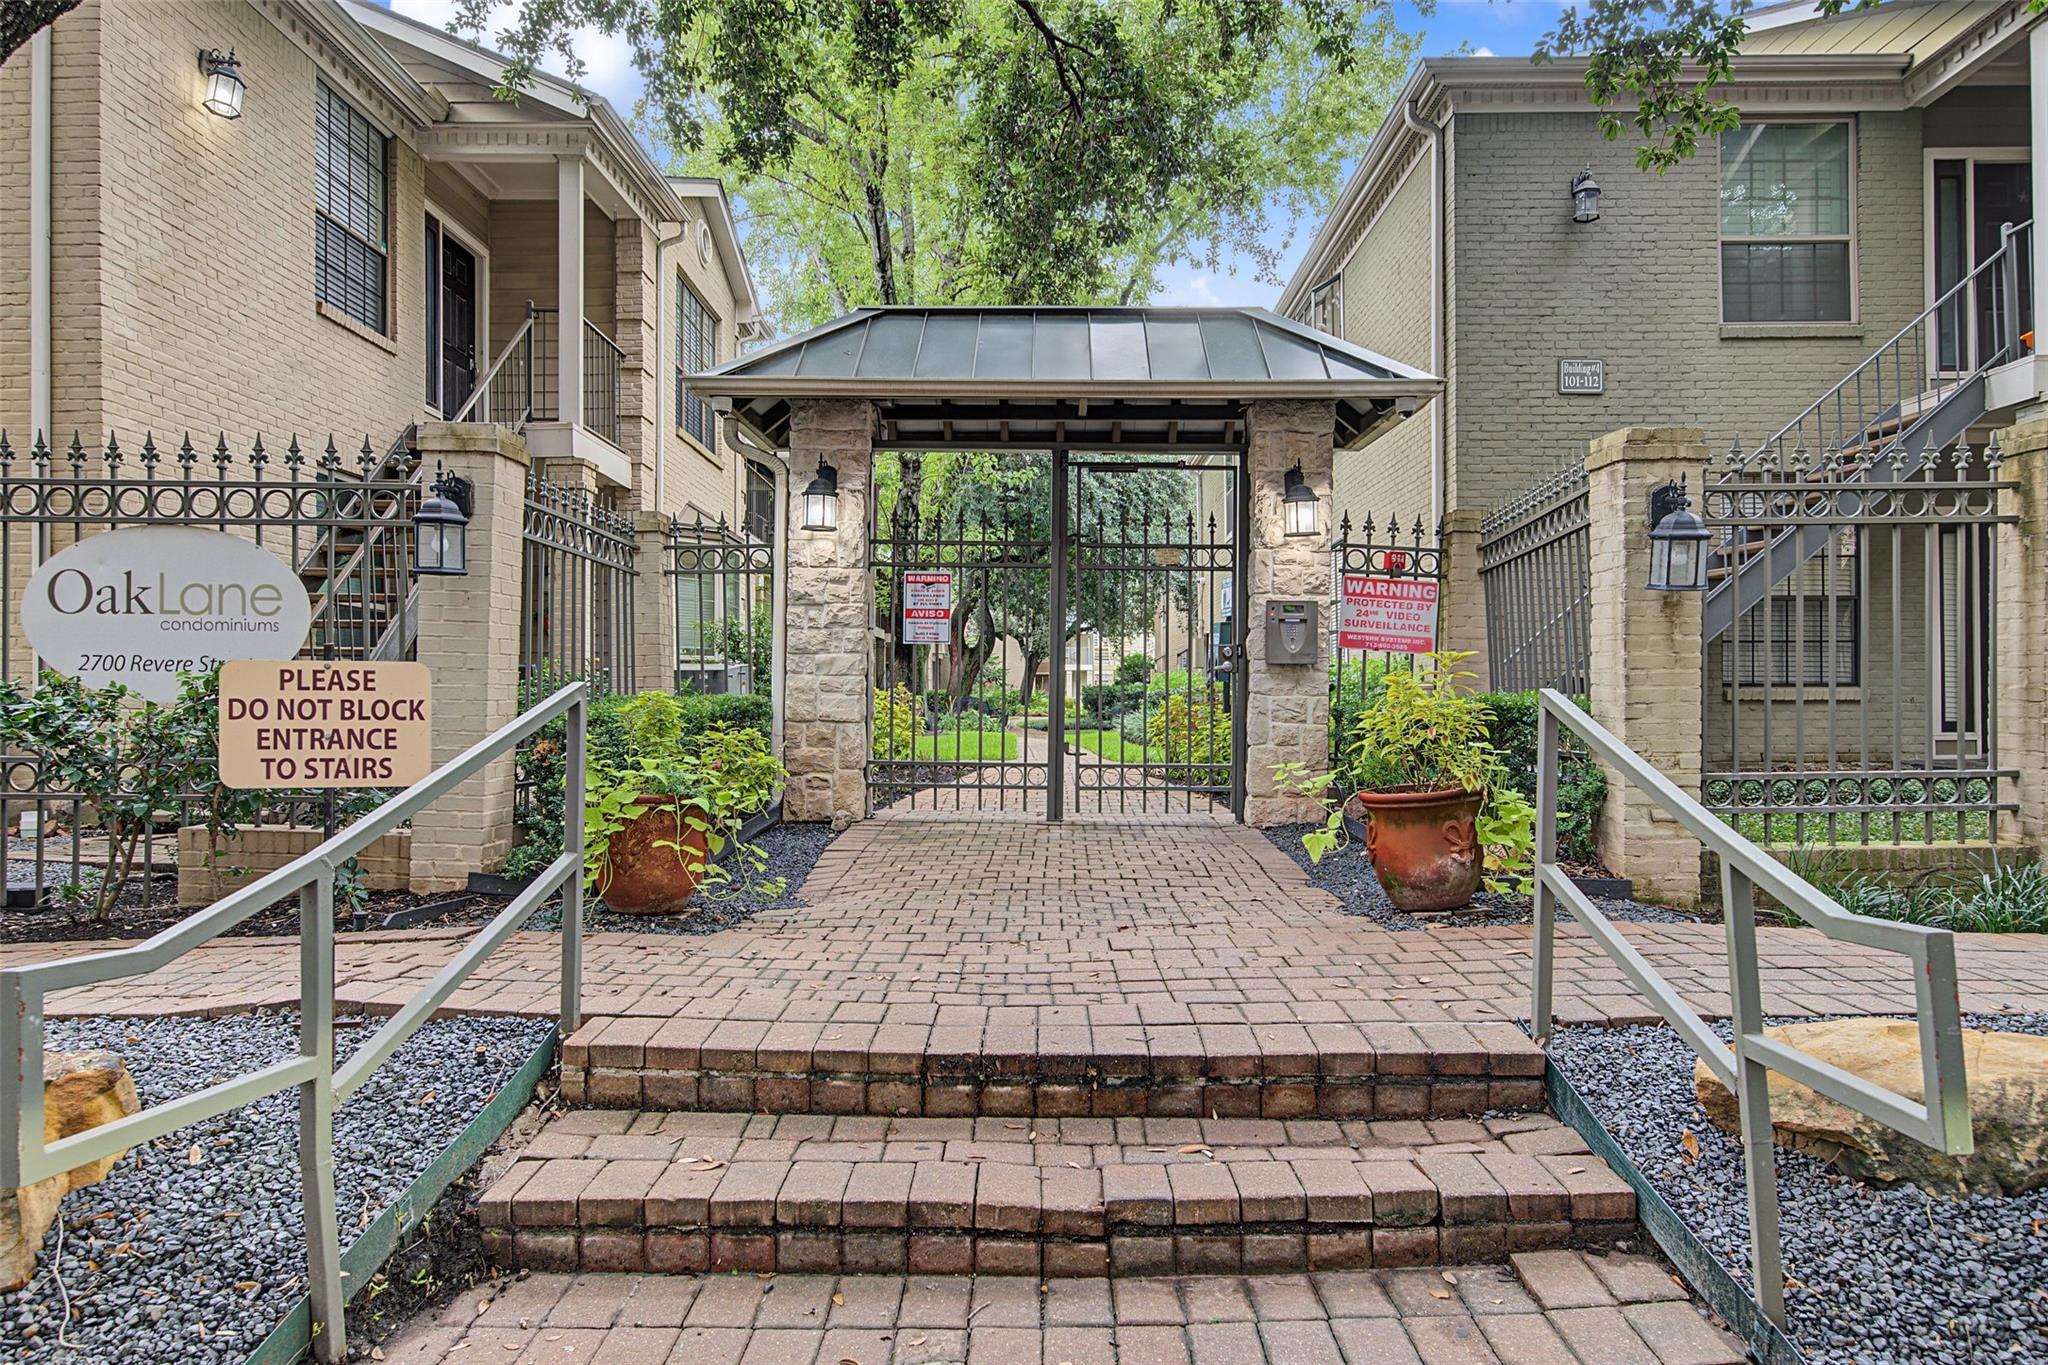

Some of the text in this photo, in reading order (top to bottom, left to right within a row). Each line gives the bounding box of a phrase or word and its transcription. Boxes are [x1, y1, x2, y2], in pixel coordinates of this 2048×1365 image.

[1564, 376, 1599, 386] 101-112
[1346, 580, 1436, 599] WARNING
[1346, 598, 1432, 611] PROTECTED BY
[160, 618, 279, 632] condominiums
[1344, 618, 1431, 632] SURVEILLANCE
[1386, 611, 1421, 621] VIDEO
[78, 654, 126, 671] 2700
[130, 655, 193, 672] Revere
[280, 669, 376, 691] PLEASE
[228, 698, 425, 721] DO NOT BLOCK
[257, 728, 398, 750] ENTRANCE
[260, 758, 393, 780] TO STAIRS
